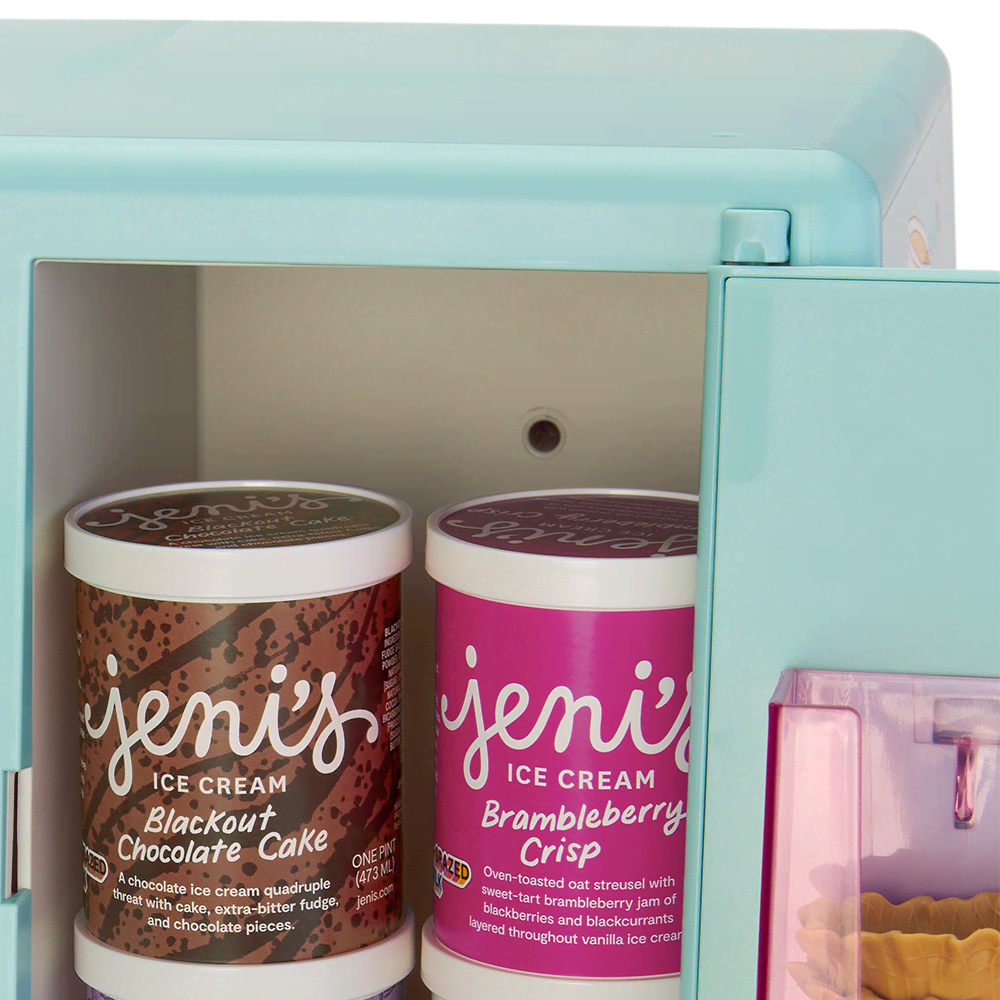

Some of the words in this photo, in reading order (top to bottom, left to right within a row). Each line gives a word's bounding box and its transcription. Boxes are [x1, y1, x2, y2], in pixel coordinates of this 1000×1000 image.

[85, 654, 378, 796] jeni's
[153, 772, 189, 793] ICE
[199, 775, 287, 794] CREAM
[508, 763, 547, 787] ICE
[558, 769, 655, 790] CREAM
[144, 804, 277, 835] Blackout
[481, 800, 687, 836] Brambleberry
[118, 833, 240, 864] Chocolate
[258, 828, 328, 861] Cake
[352, 848, 378, 868] ONE
[380, 838, 396, 860] PINT
[520, 836, 602, 869] Crisp
[128, 875, 187, 895] chocolate
[190, 882, 211, 896] ice
[214, 886, 260, 898] cream
[264, 878, 330, 898] quadruple
[355, 865, 379, 888] (473
[483, 866, 564, 888] Oven-toasted
[568, 878, 590, 890] oat
[594, 878, 645, 891] streusel
[649, 876, 675, 888] with
[113, 887, 144, 906] threat
[145, 897, 172, 911] with
[176, 902, 210, 916] cake,
[215, 901, 296, 916] extra-bitter
[300, 894, 340, 911] fudge,
[356, 884, 394, 910] jenis.com
[482, 884, 540, 904] sweet-tart
[544, 894, 634, 912] brambleberry
[636, 896, 660, 910] jam
[664, 892, 677, 905] of
[148, 914, 170, 929] and
[174, 918, 242, 934] chocolate
[246, 920, 295, 936] pieces.
[483, 902, 554, 924] blackberries
[558, 914, 581, 926] and
[586, 913, 674, 927] blackcurrants
[469, 916, 505, 936] layered
[508, 926, 578, 945] throughout
[582, 932, 624, 945] vanilla
[628, 932, 646, 944] ice
